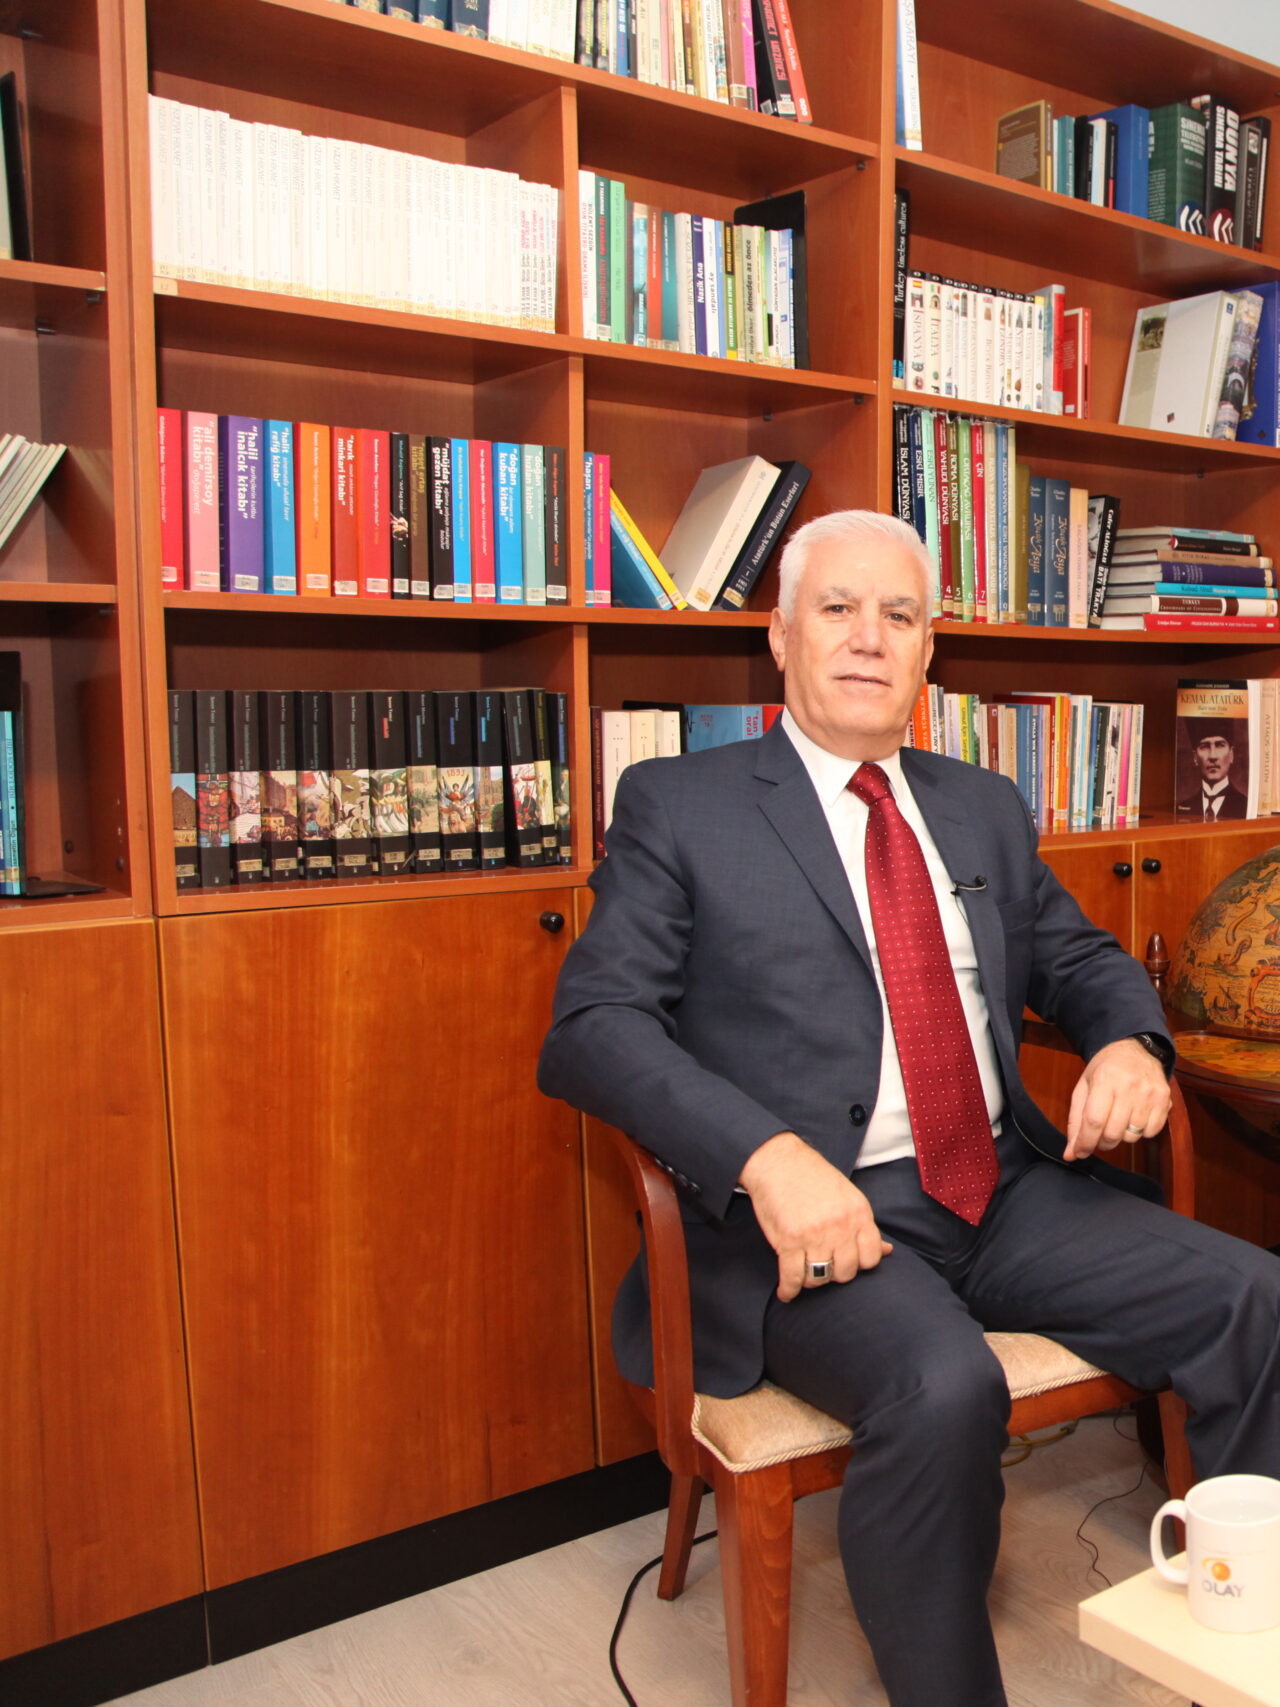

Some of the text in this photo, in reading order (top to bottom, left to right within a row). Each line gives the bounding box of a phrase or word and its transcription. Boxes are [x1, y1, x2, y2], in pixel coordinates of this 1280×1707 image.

[894, 272, 906, 303] Turkey
[247, 425, 259, 460] "halil
[202, 446, 215, 507] demirsoy
[237, 431, 249, 520] inalcık kitabı"
[432, 447, 443, 515] gezen kitabı"
[440, 443, 450, 484] "müjdat
[508, 448, 518, 486] "doğan
[499, 452, 509, 521] kuban kitabı"
[900, 447, 913, 520] İSLAM DÜNYASI
[941, 486, 951, 525] DÜNYASI
[1105, 509, 1115, 529] Cafer
[1092, 587, 1102, 617] TRAKYA
[1209, 694, 1245, 705] ATATÜRK
[1201, 1579, 1245, 1598] OLAY
